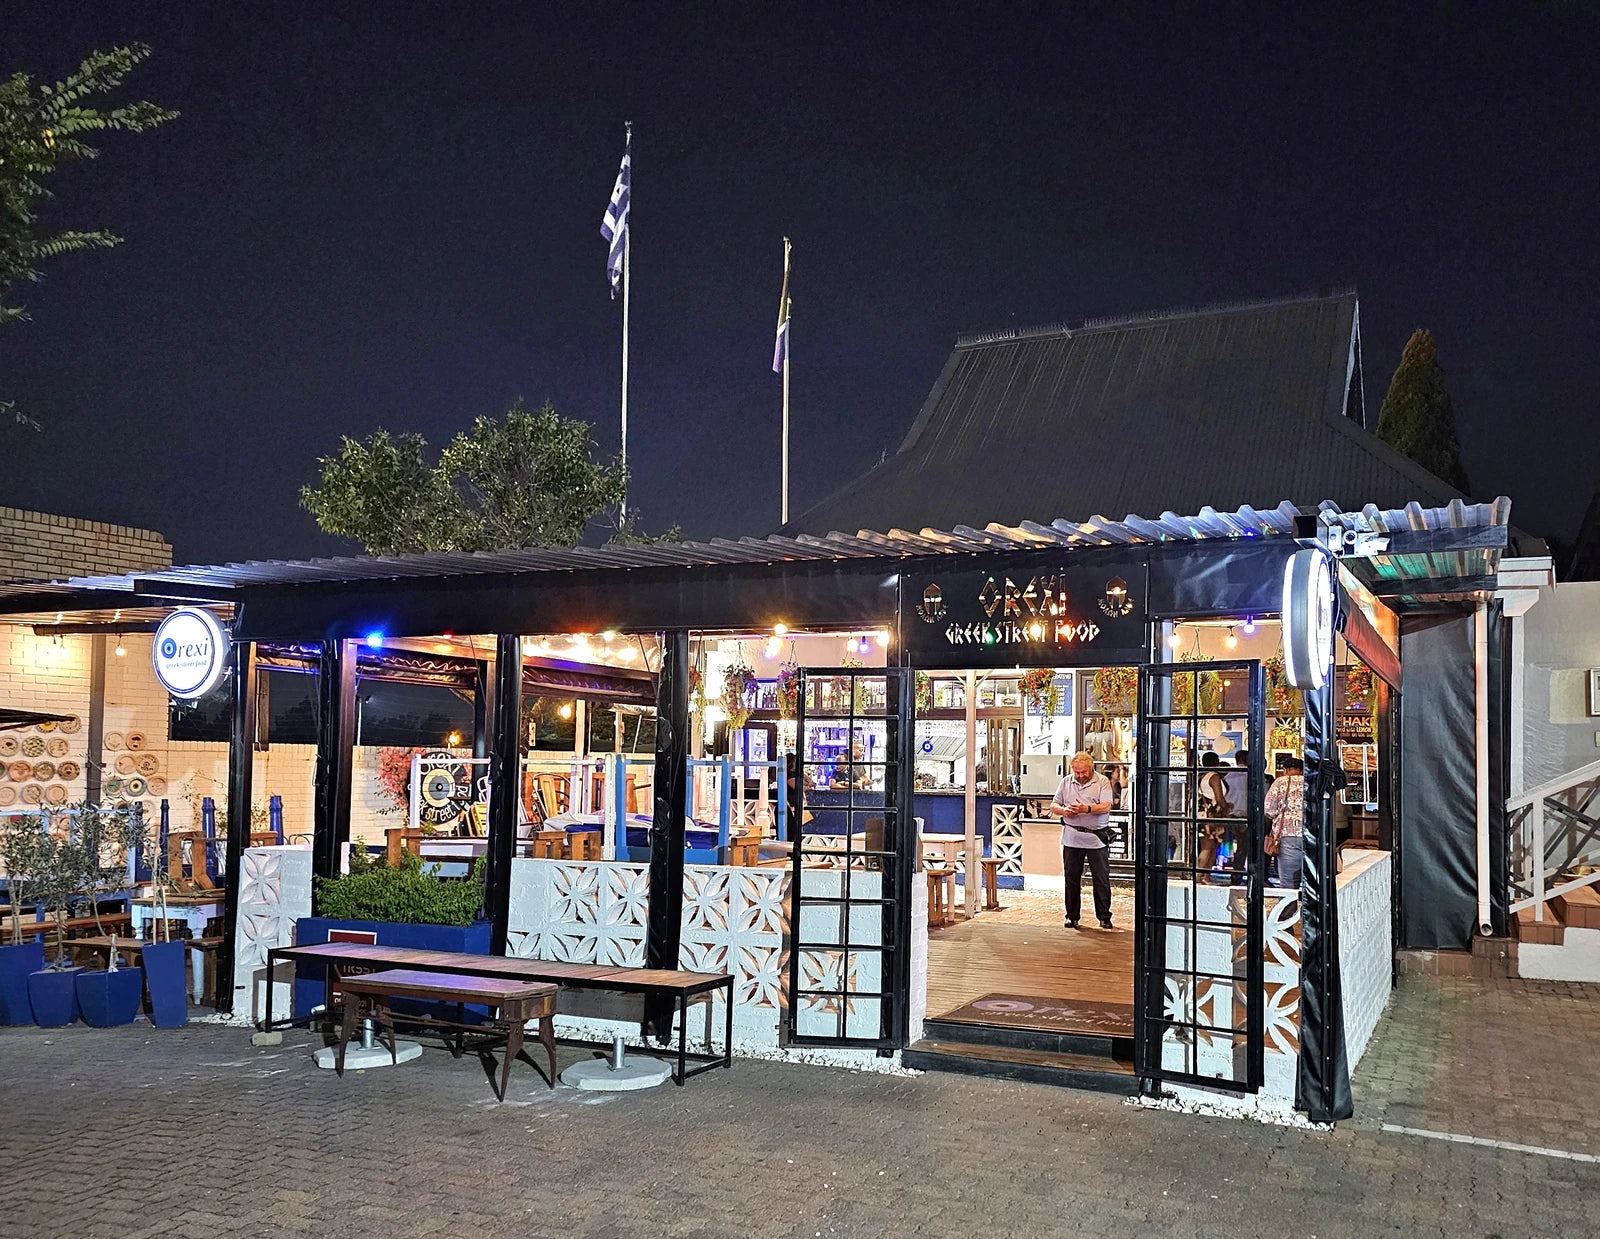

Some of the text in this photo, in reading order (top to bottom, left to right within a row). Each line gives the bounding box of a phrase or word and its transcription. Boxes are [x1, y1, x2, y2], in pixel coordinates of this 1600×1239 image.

[978, 574, 1066, 618] OREXI
[945, 618, 1100, 644] GREEK STREET FOOD
[161, 637, 209, 659] Orexi
[1096, 1018, 1135, 1028] foo
